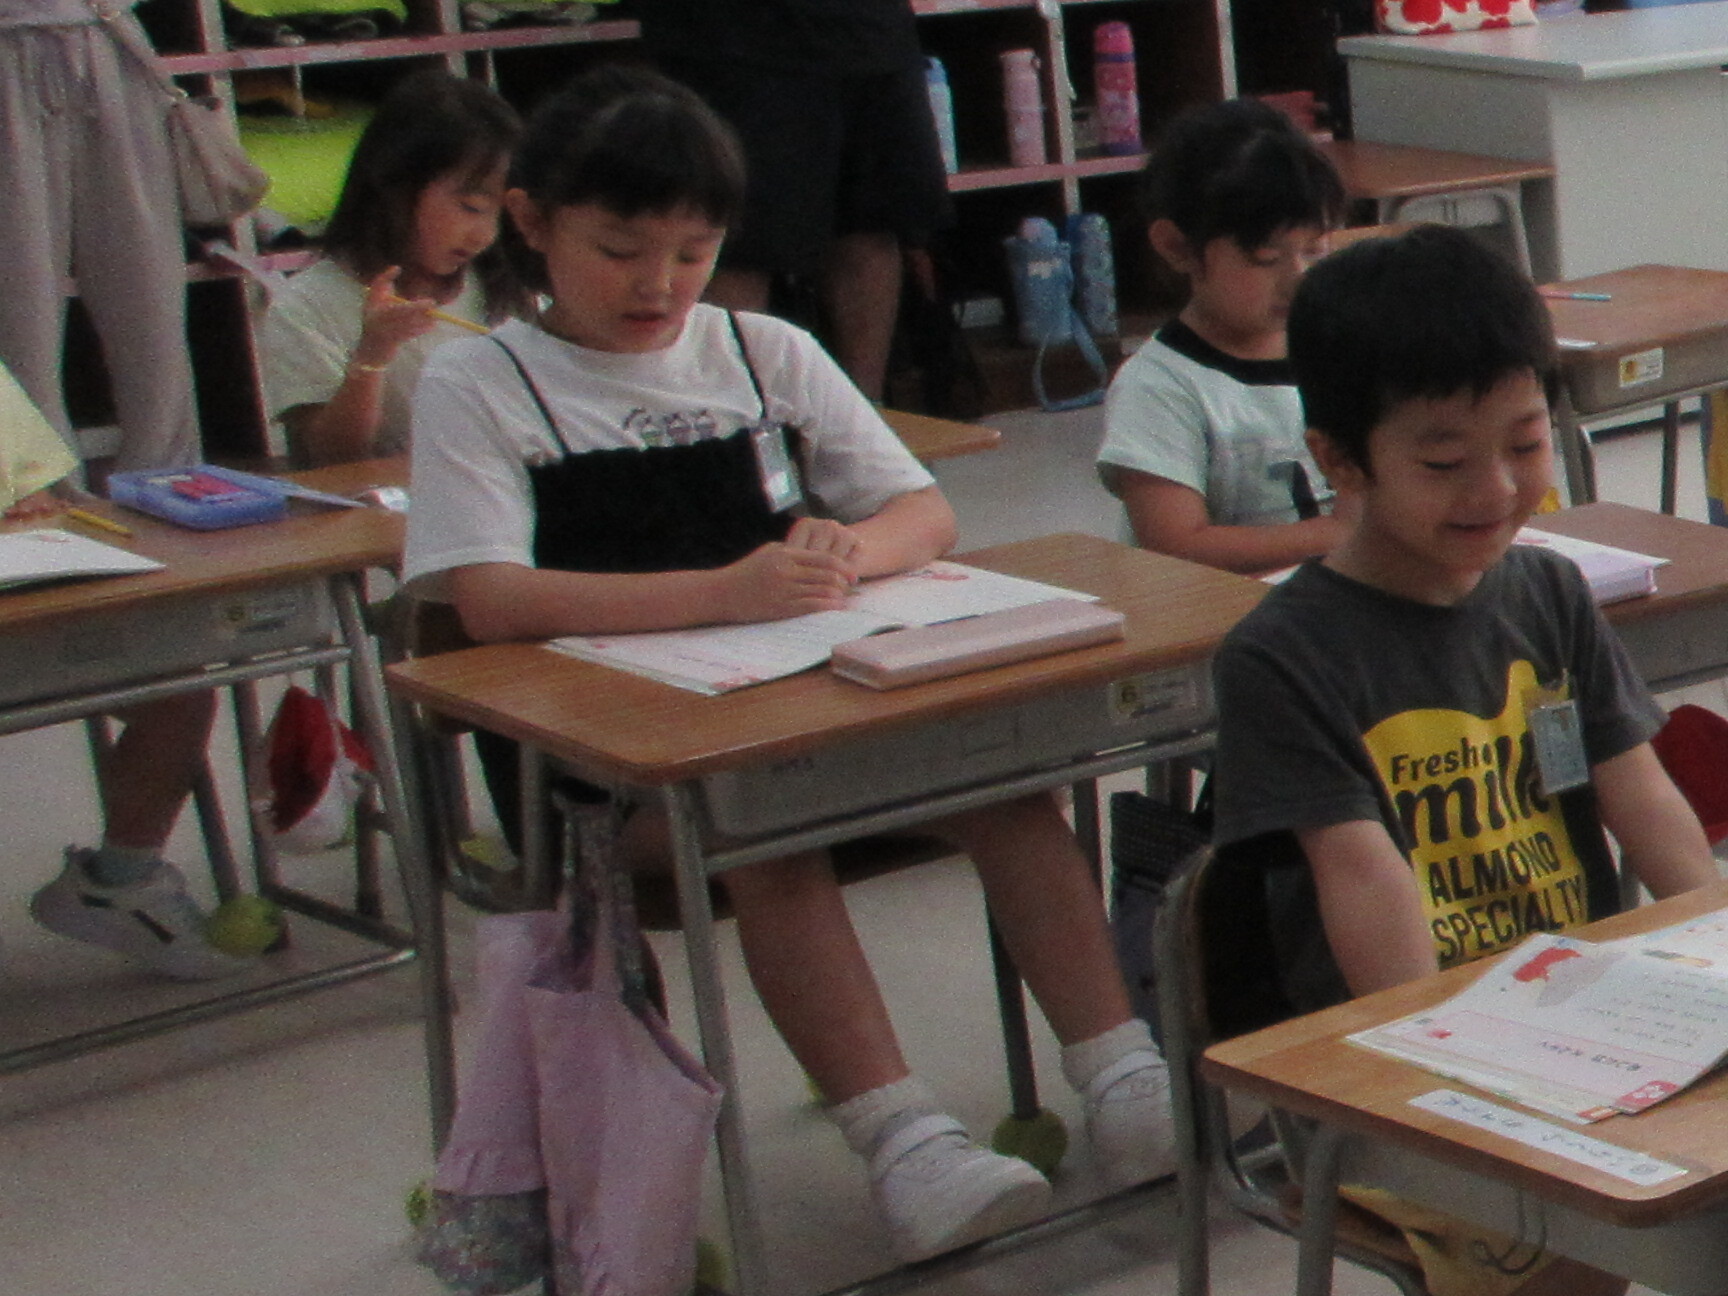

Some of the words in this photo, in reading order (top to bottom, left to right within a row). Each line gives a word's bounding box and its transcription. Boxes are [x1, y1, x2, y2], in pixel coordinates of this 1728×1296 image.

[1390, 736, 1481, 786] Fresh
[1426, 830, 1562, 908] ALMOND
[1431, 874, 1588, 964] SPECIALTY
